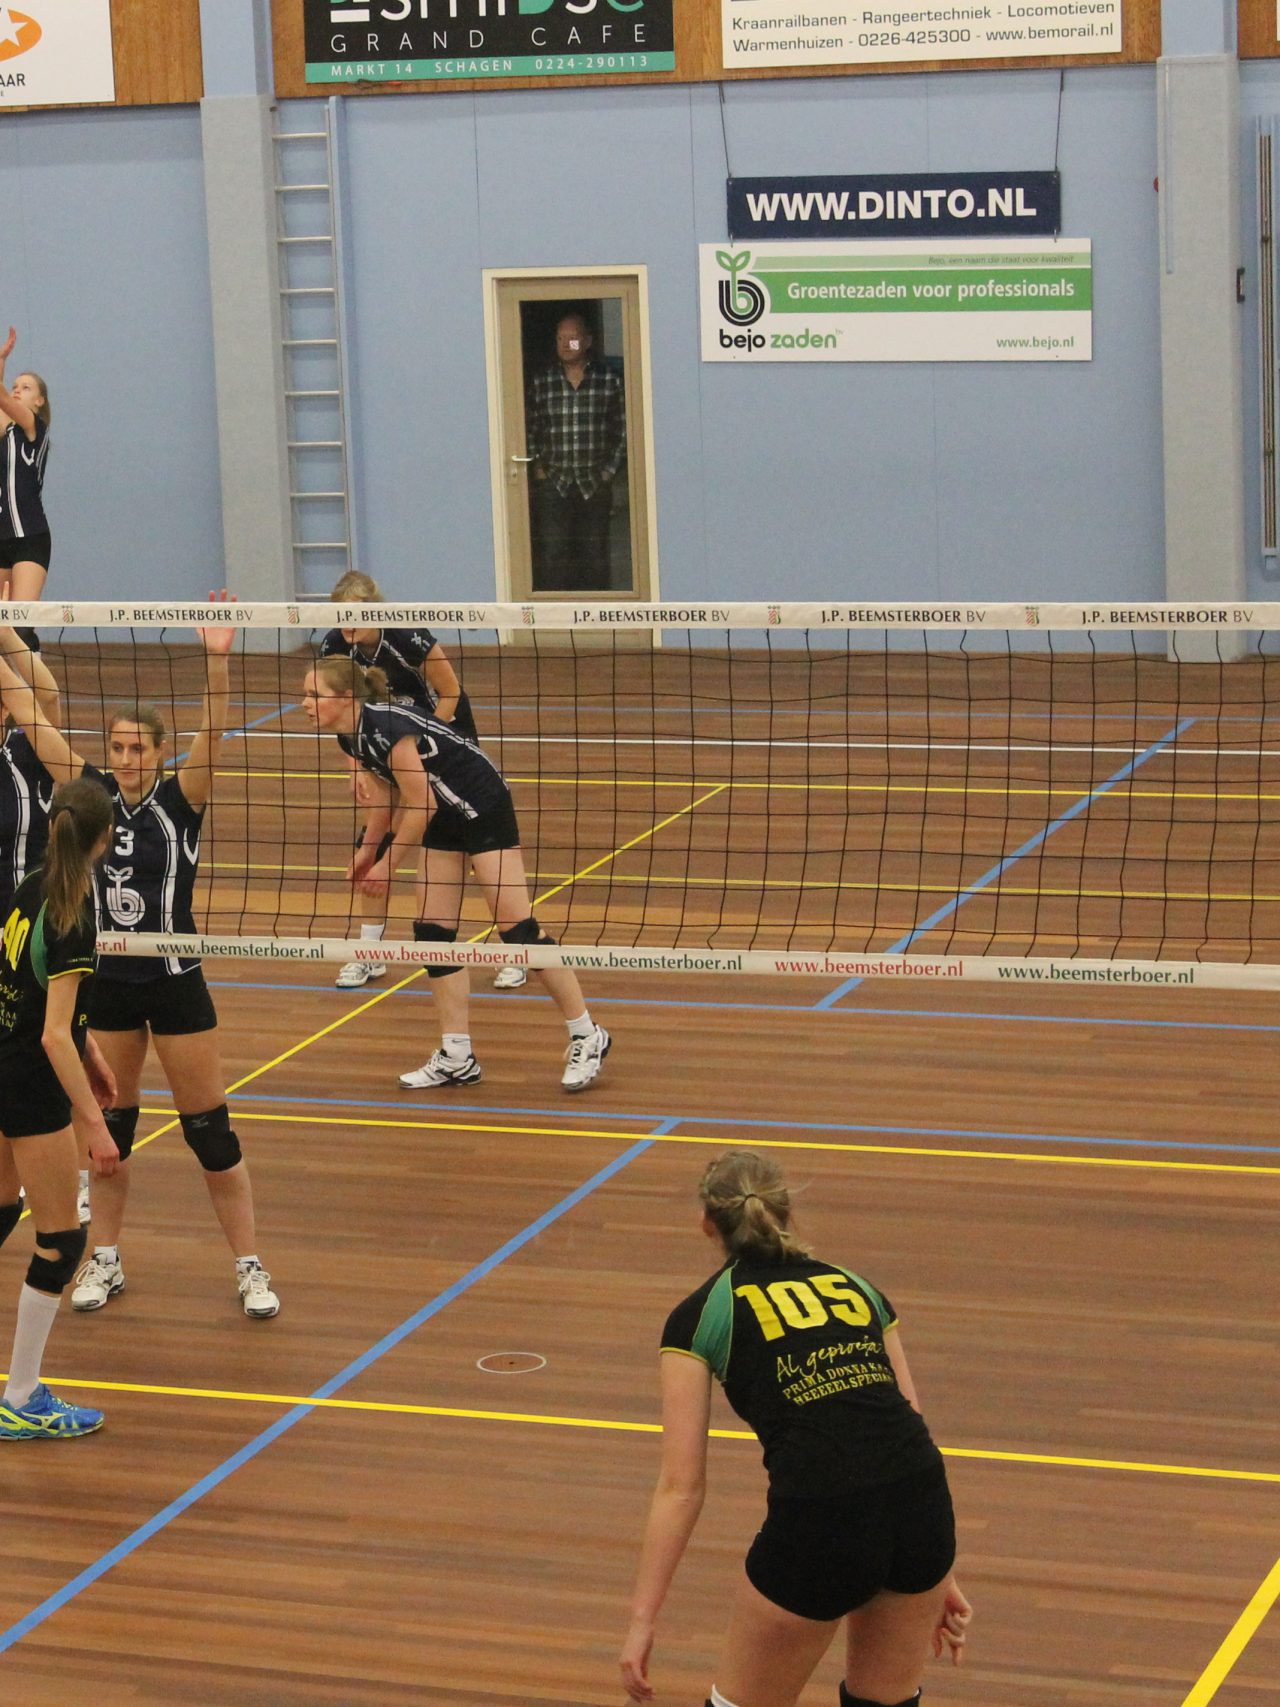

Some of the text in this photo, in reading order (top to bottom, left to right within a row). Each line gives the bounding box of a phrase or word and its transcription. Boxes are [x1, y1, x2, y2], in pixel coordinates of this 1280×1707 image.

[732, 13, 847, 31] Kraanrailbanen
[862, 6, 992, 27] Rangeertechniek
[1007, 2, 1114, 18] Locomotieven
[331, 24, 645, 53] GRAND CAFE
[733, 36, 843, 52] Warmenhuizen
[858, 29, 970, 47] 0226-425300
[986, 23, 1113, 41] www.bemorail.nl
[331, 56, 648, 76] MARKT 14 SCHAGEN 0224-290113
[746, 187, 1037, 221] WWW.DINTO.NL
[787, 279, 1074, 301] Groentezaden voor professionals
[719, 328, 766, 352] bejo
[770, 328, 836, 348] zaden
[996, 335, 1075, 350] www.bejo.nl
[13, 610, 29, 620] BV
[110, 610, 252, 621] J.P. BEEMSTERBOER BV
[337, 610, 485, 623] J.P. BEEMSTERBOER BV
[574, 610, 729, 623] J.P. BEEMSTERBOER BV
[822, 610, 985, 623] J.P. BEEMSTERBOER BV
[1082, 610, 1253, 624] J.P. BEEMSTERBOER BV
[115, 826, 135, 856] 3
[156, 940, 325, 960] www.beemsterboer.nl
[354, 945, 529, 966] www.beemsterboer.nl
[561, 950, 742, 972] www.beemsterboer.nl
[775, 956, 963, 978] www.beemsterboer.nl
[997, 963, 1194, 986] www.beemsterboer.nl
[734, 1273, 871, 1342] 105
[783, 1372, 826, 1399] PRIMA
[826, 1363, 868, 1380] DONNA
